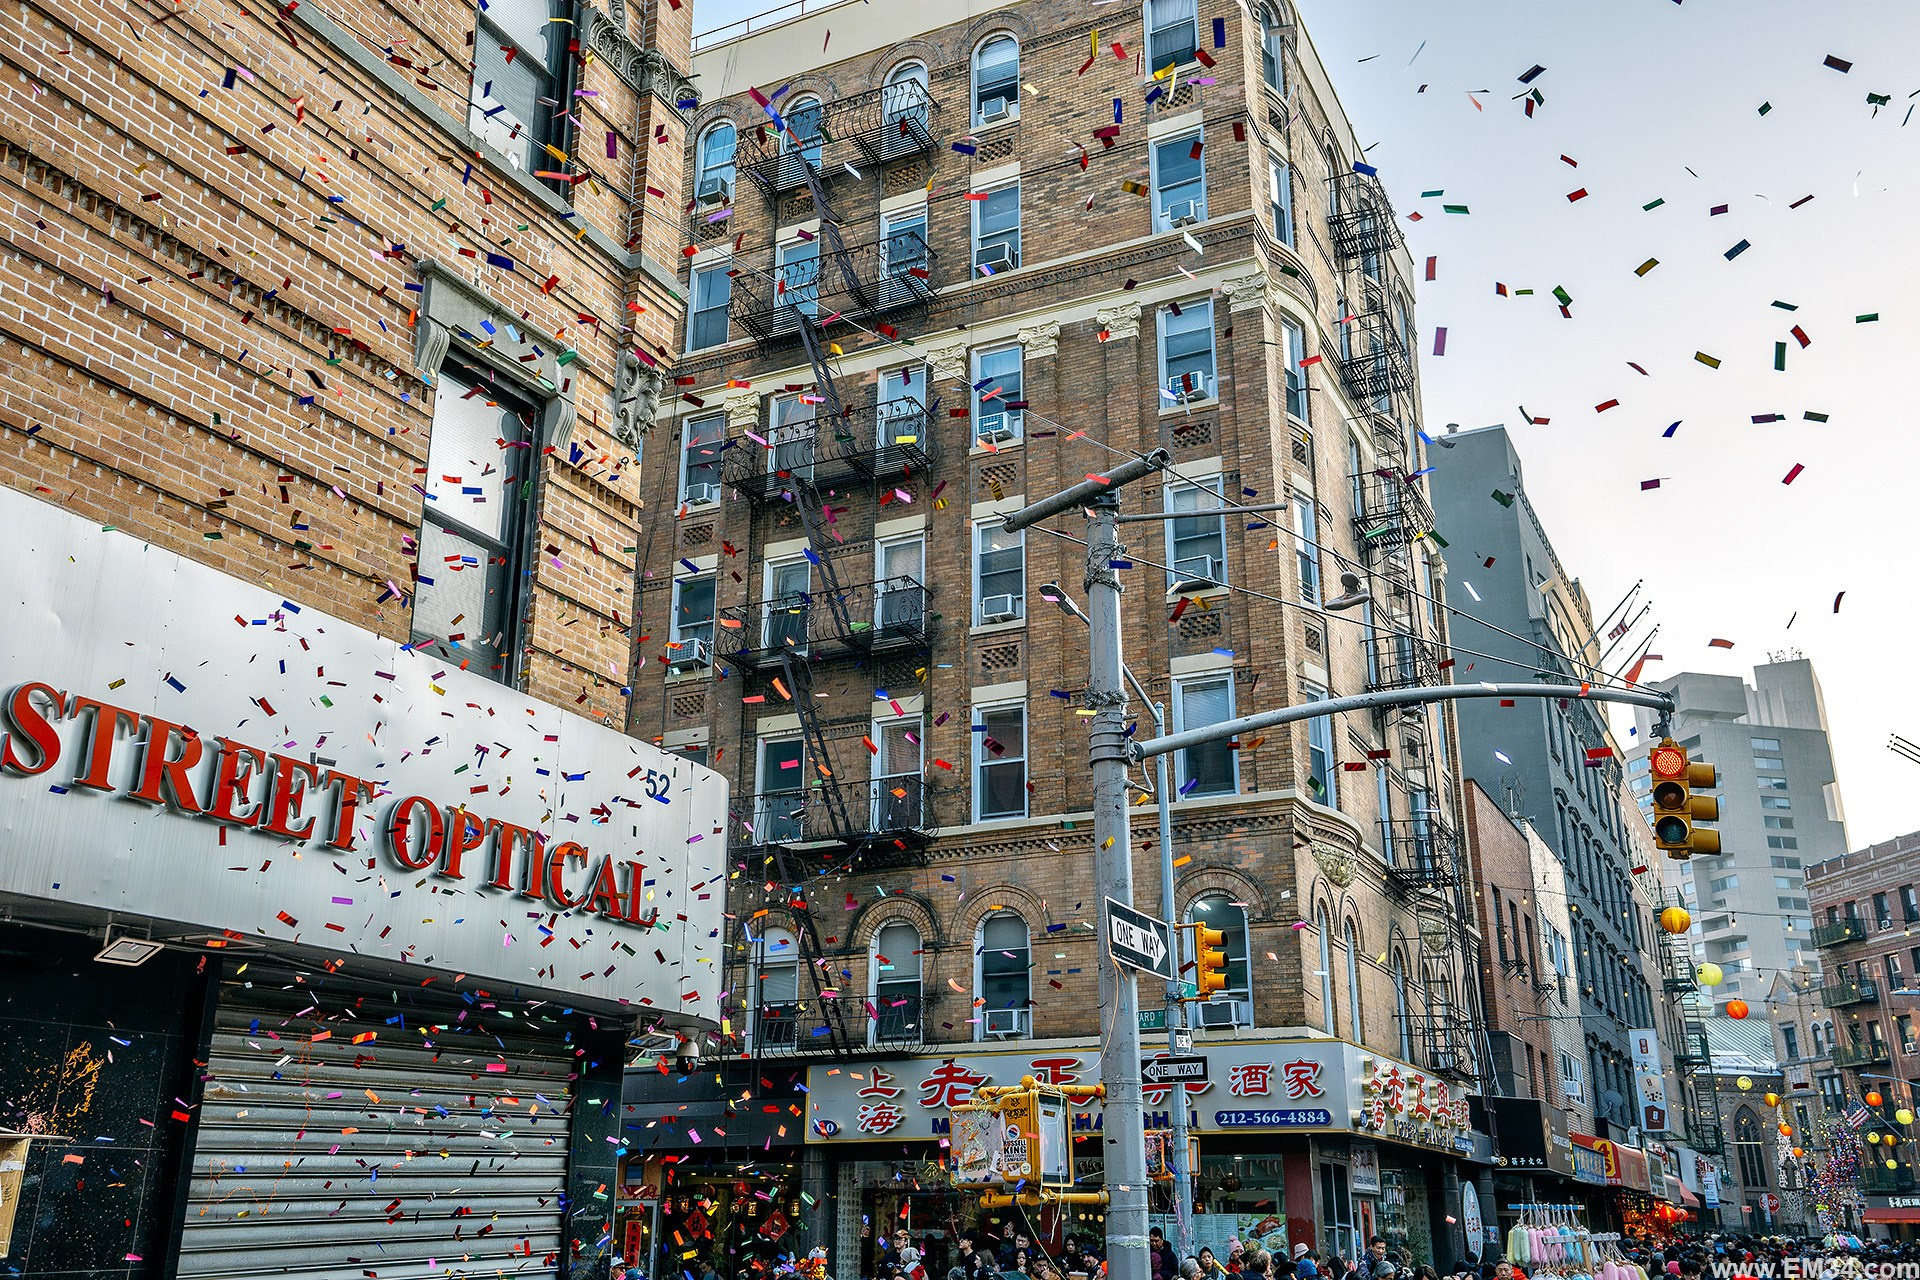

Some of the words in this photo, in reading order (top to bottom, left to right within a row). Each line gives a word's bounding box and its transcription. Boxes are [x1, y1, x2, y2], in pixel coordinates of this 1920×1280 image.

[646, 768, 670, 799] 52
[1, 681, 386, 852] STREET
[389, 795, 659, 926] OPTICAL
[1116, 920, 1135, 948] ONE
[1140, 931, 1160, 958] WAY
[1149, 1065, 1169, 1077] ONE
[1177, 1063, 1199, 1075] WAY
[856, 1065, 901, 1135] 上海
[1228, 1057, 1325, 1100] 酒家
[1219, 1111, 1327, 1125] 212-566-4884
[1003, 1146, 1027, 1154] KING
